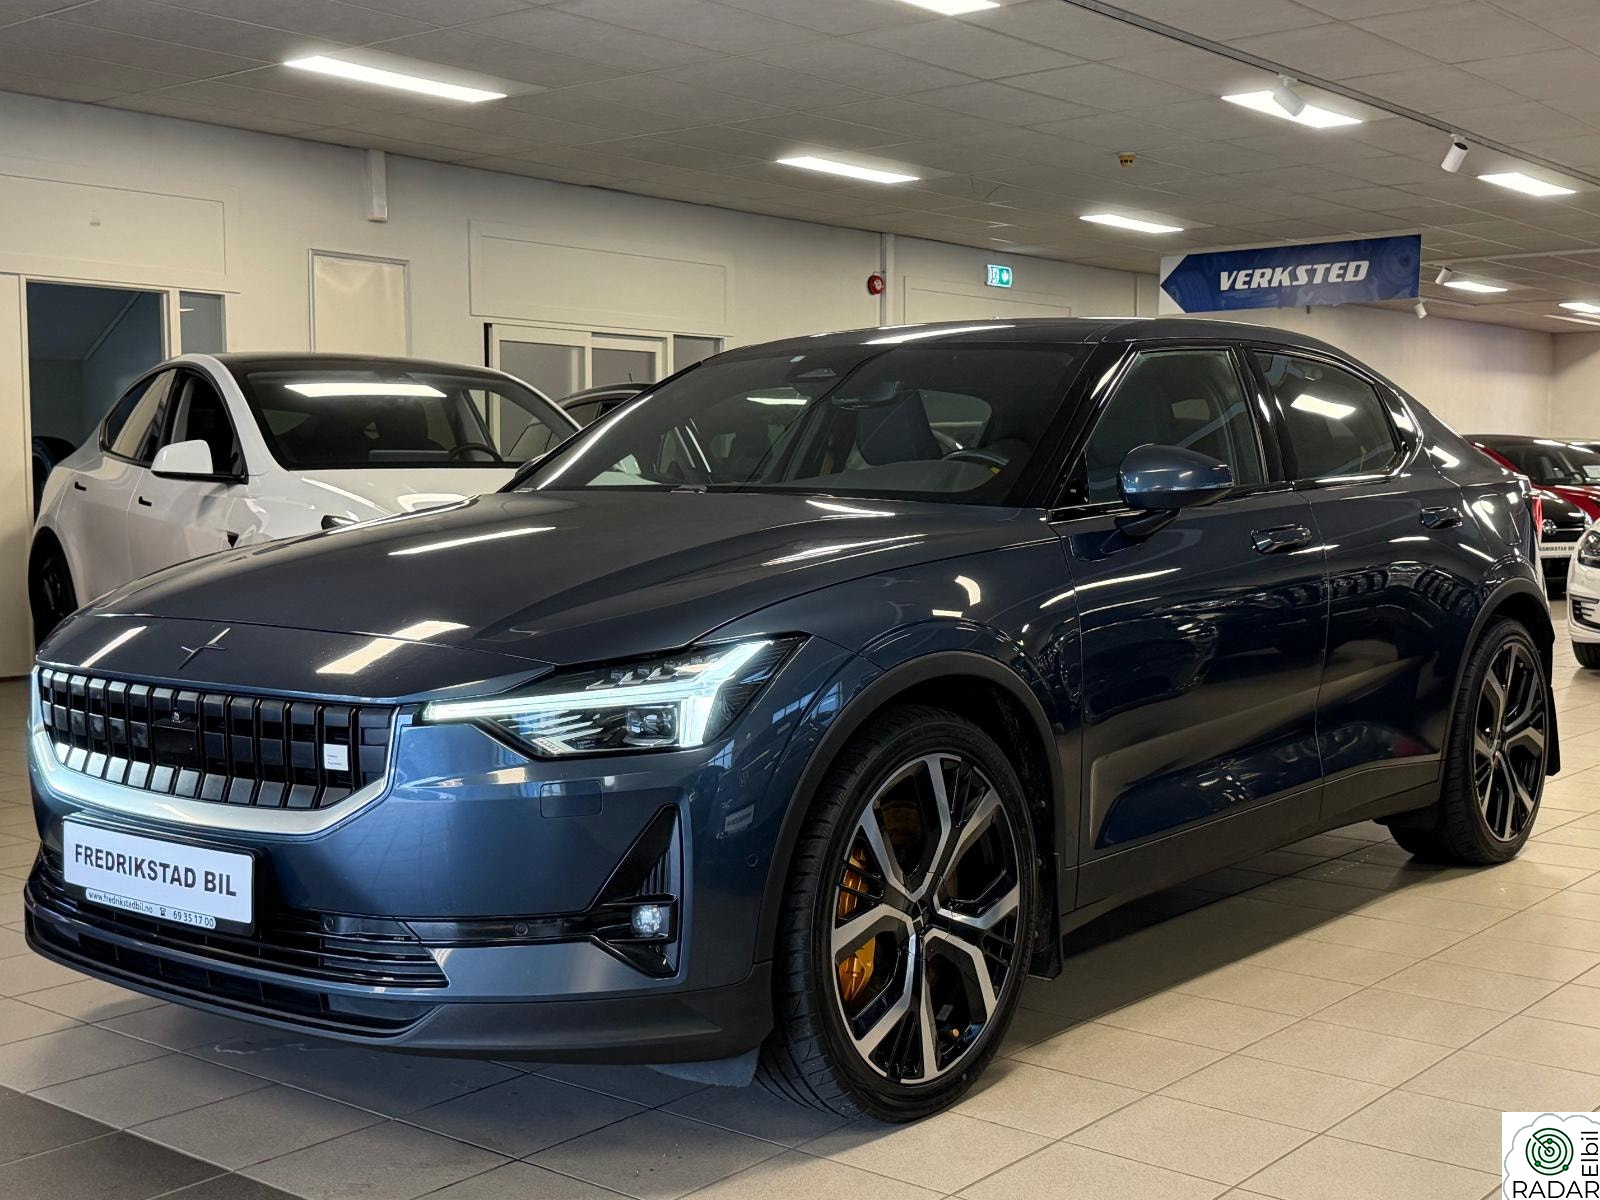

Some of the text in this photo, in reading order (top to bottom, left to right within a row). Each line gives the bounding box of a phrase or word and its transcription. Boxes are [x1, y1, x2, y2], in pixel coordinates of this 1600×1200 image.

[1220, 260, 1370, 291] VERKSTED
[75, 843, 237, 897] FREDRIKSTAD BIL
[88, 891, 214, 927] www.fredrikstadbil.no 69 35 17 00
